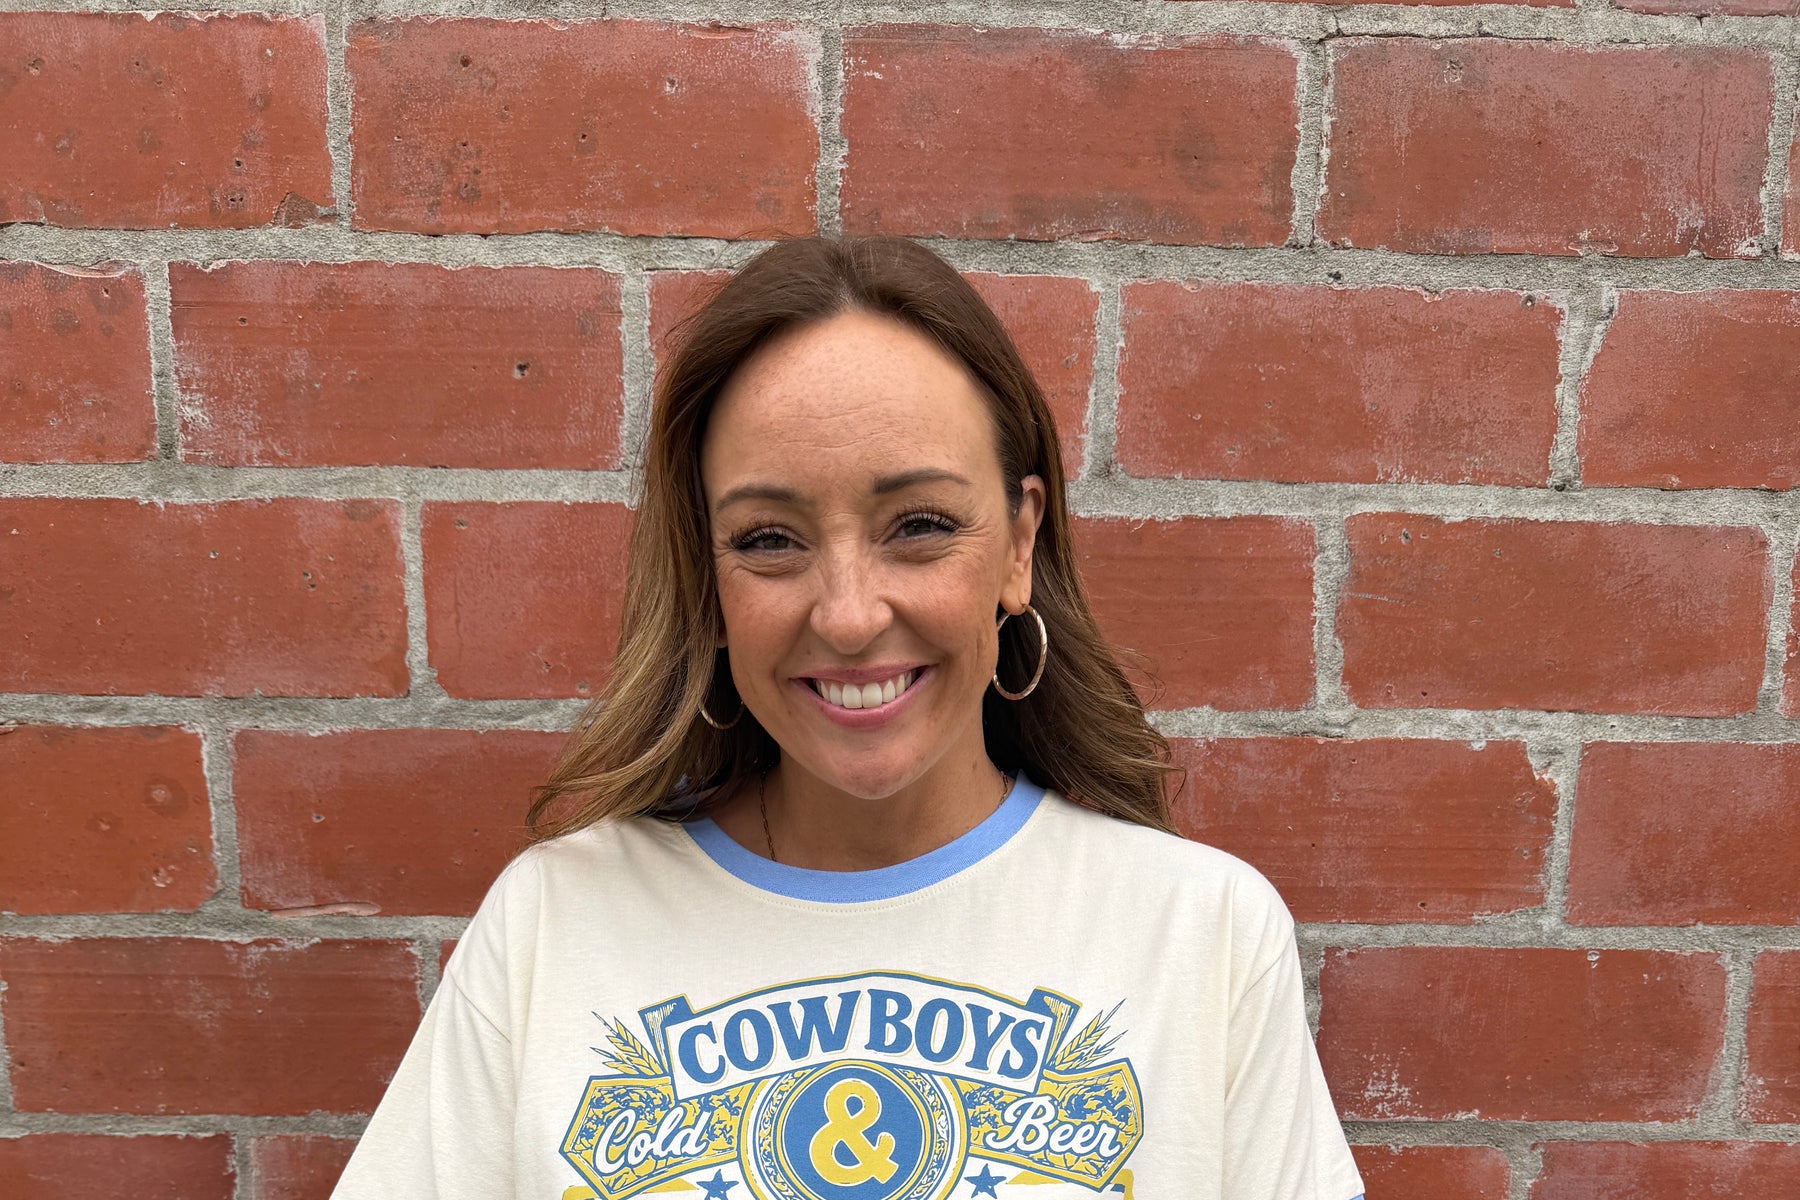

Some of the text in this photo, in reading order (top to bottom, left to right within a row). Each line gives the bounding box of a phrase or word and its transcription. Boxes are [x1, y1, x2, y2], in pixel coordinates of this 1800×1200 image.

[678, 988, 1044, 1084] COWBOYS
[594, 1077, 1121, 1187] Cold & Beer
